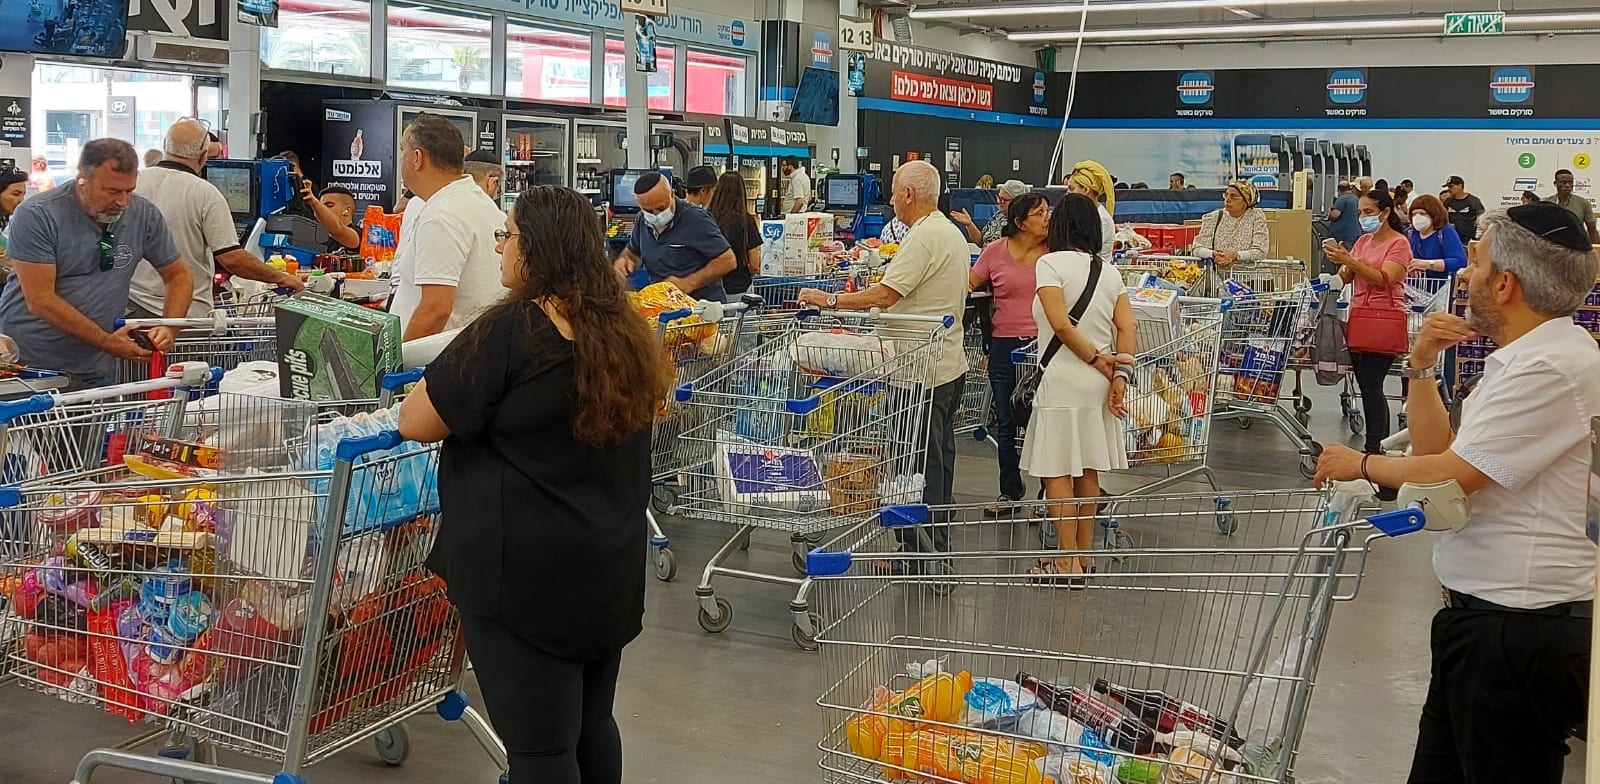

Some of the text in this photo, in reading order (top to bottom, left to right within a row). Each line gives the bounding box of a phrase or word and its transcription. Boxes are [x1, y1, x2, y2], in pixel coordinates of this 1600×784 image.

[655, 14, 678, 29] עכש
[681, 16, 702, 34] הורד
[841, 28, 872, 46] 12 13
[893, 45, 924, 69] סורקים
[925, 51, 967, 76] אפליקציית
[967, 59, 979, 76] עם
[980, 61, 997, 83] קניה
[920, 80, 938, 99] לפני
[940, 84, 957, 102] וצאו
[958, 85, 977, 107] לכאן
[978, 89, 991, 106] גשו
[708, 127, 721, 137] מים
[751, 129, 767, 139] פחית
[786, 131, 806, 144] בקבוק
[1522, 156, 1530, 165] 3
[1578, 157, 1585, 165] 2
[335, 163, 380, 176] אלכומטי
[360, 183, 386, 192] משקאות
[284, 349, 314, 400] cue pits
